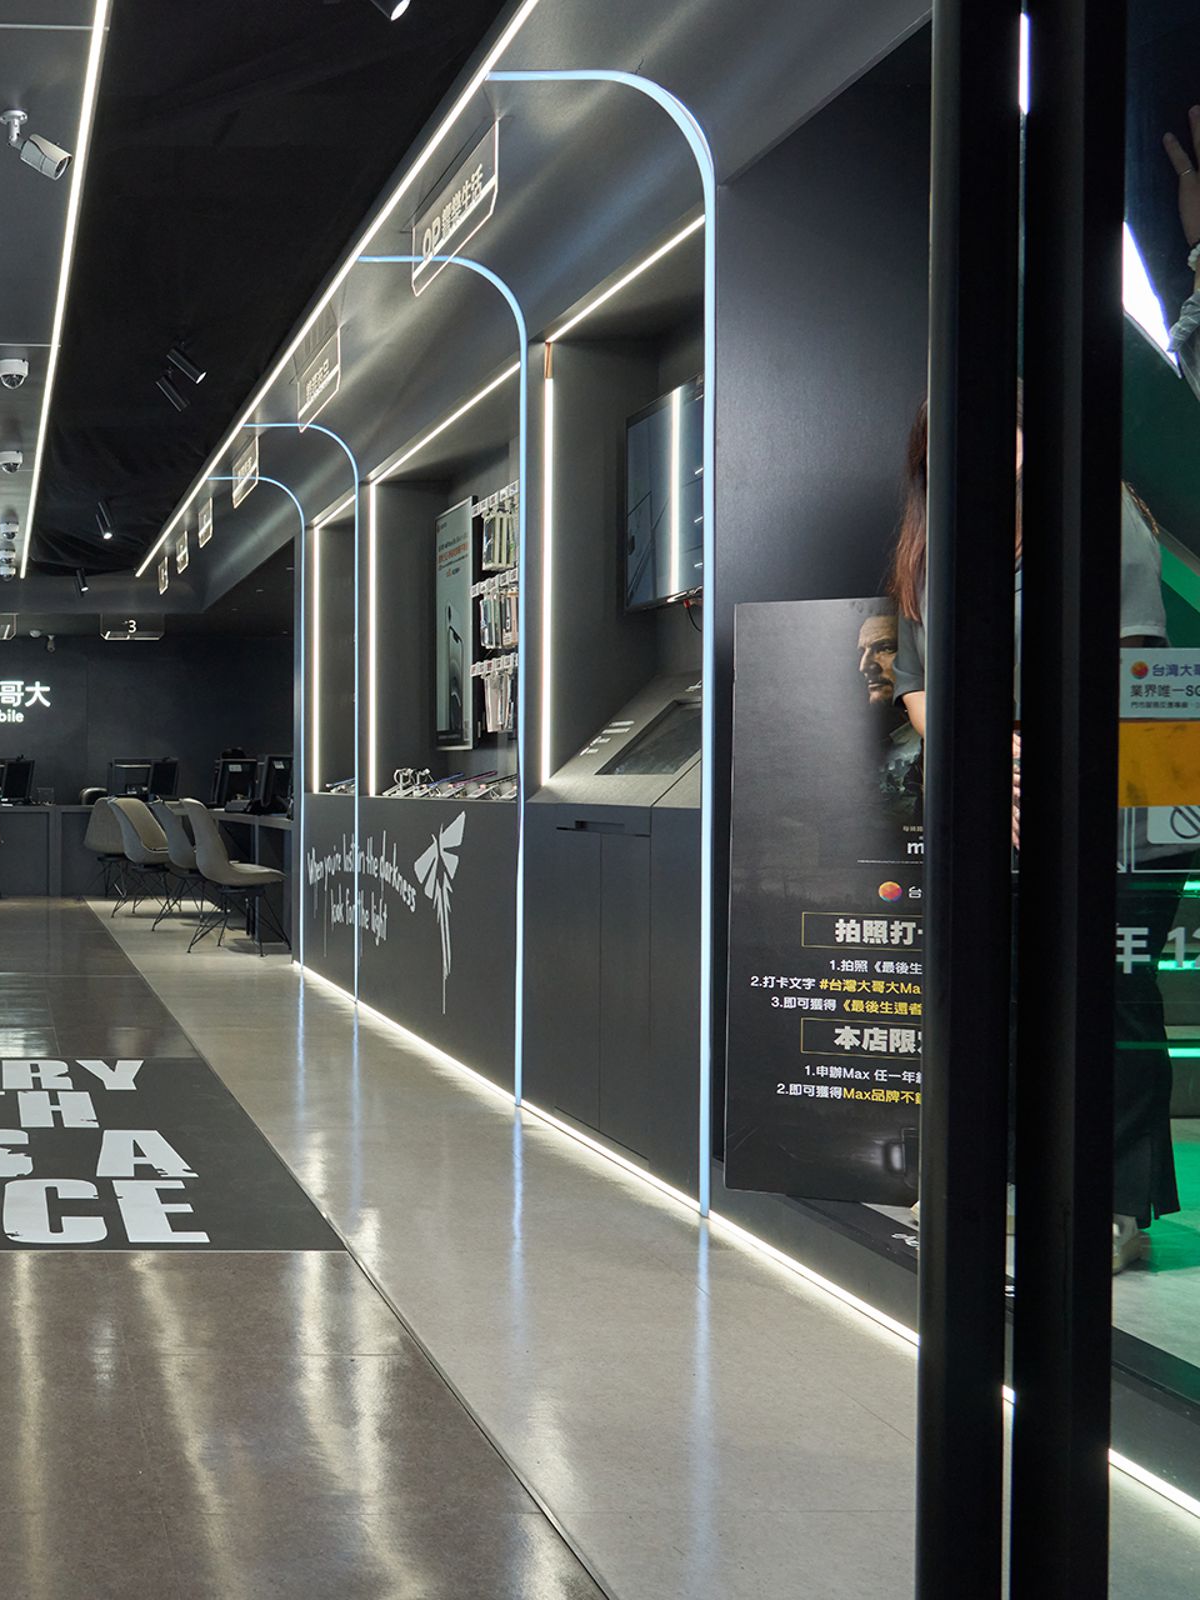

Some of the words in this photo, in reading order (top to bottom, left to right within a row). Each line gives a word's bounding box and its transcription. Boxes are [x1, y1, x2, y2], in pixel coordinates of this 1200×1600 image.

[127, 620, 137, 634] 3
[307, 847, 324, 886] When
[366, 836, 379, 878] the
[380, 830, 417, 913] darkness
[331, 883, 344, 925] look
[371, 891, 387, 946] light
[834, 918, 923, 946] 拍照打
[834, 1025, 921, 1055] 本店限
[95, 1129, 200, 1178] A
